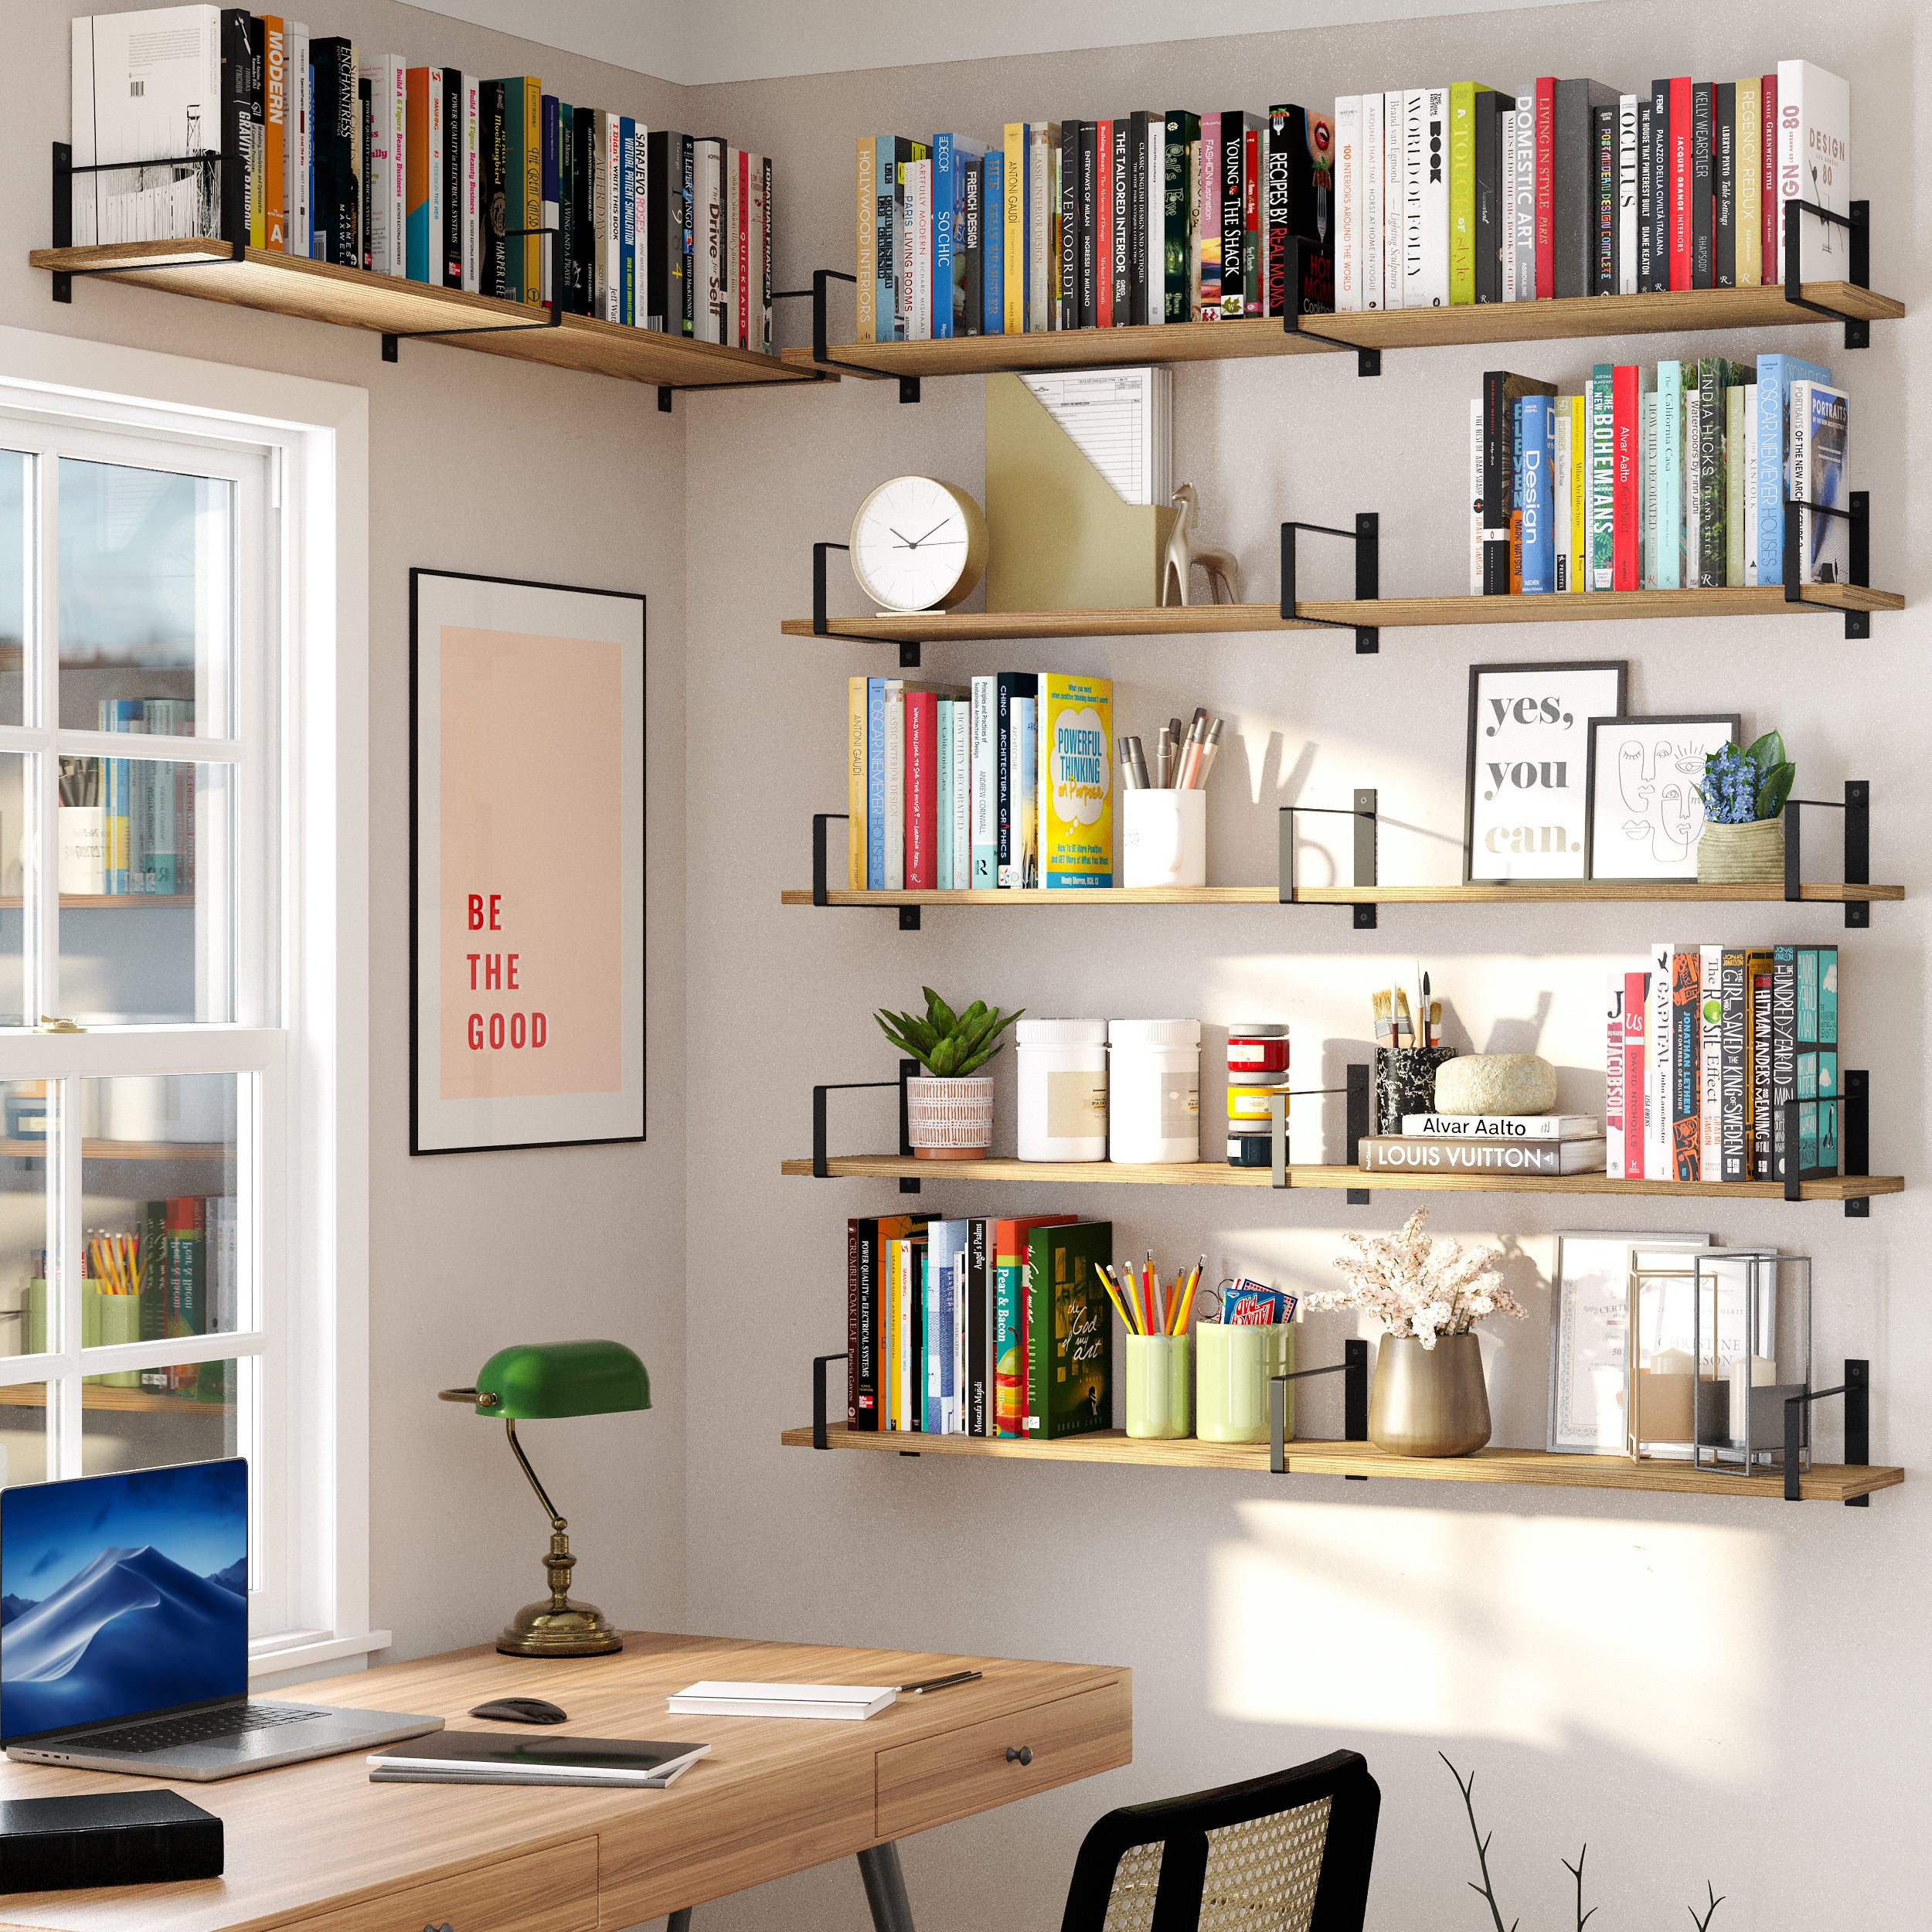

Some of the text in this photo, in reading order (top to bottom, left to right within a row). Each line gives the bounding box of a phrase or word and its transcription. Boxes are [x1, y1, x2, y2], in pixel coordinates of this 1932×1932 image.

[270, 30, 282, 124] MODERN
[340, 47, 352, 138] ENCHANTRESS
[1539, 98, 1549, 144] LIVING
[1696, 92, 1708, 177] KELLY WEARSTLER
[1430, 121, 1441, 184] BOOK
[1517, 97, 1532, 249] DOMESTIC ART
[1539, 148, 1549, 162] IN
[1621, 112, 1636, 207] OCULUS
[1743, 91, 1754, 219] REGENCY REDUX
[624, 138, 633, 244] VIRTUAL PATIENT SIMULATION
[636, 134, 645, 233] SARAJEVO ROSES
[967, 172, 976, 248] FRENCH DESIGN
[1084, 192, 1090, 202] OF
[1116, 132, 1125, 273] THE TAILORED INTERIOR
[1225, 138, 1240, 277] YOUNG THE SHACK
[1539, 168, 1549, 209] STYLE
[1657, 191, 1665, 219] CIVILTÀ
[709, 203, 719, 258] Drive
[859, 151, 870, 322] HOLLYWOOD INTERIORS
[938, 212, 949, 267] SO CHIC
[1388, 213, 1400, 289] Lighting Sculptures
[495, 242, 505, 295] HARPER LEE
[709, 277, 719, 316] Self
[1594, 392, 1603, 410] NEW
[1702, 375, 1713, 475] INDIA HICKS
[1523, 451, 1539, 543] Design
[1621, 427, 1630, 532] Alvar Aalto Architect
[1761, 379, 1777, 566] OSCAR NIEMEYER HOUSES
[1059, 728, 1101, 756] POWERFUL
[1486, 696, 1573, 736] yes,
[1060, 756, 1100, 784] THINKING
[1485, 761, 1570, 801] you
[1485, 826, 1581, 853] can.
[468, 893, 502, 931] BE
[467, 954, 519, 990] THE
[468, 1012, 547, 1051] GOOD
[1755, 990, 1770, 1084] HITMAN ANDERS
[1607, 1041, 1623, 1116] JACOBSON
[1423, 1117, 1526, 1136] Alvar Aalto
[1379, 1146, 1541, 1168] LOUIS VUITTON
[973, 1224, 984, 1270] Angel's Psalms
[998, 1269, 1009, 1342] Pear & Bacon
[974, 1382, 984, 1432] Mostafa Majidi
